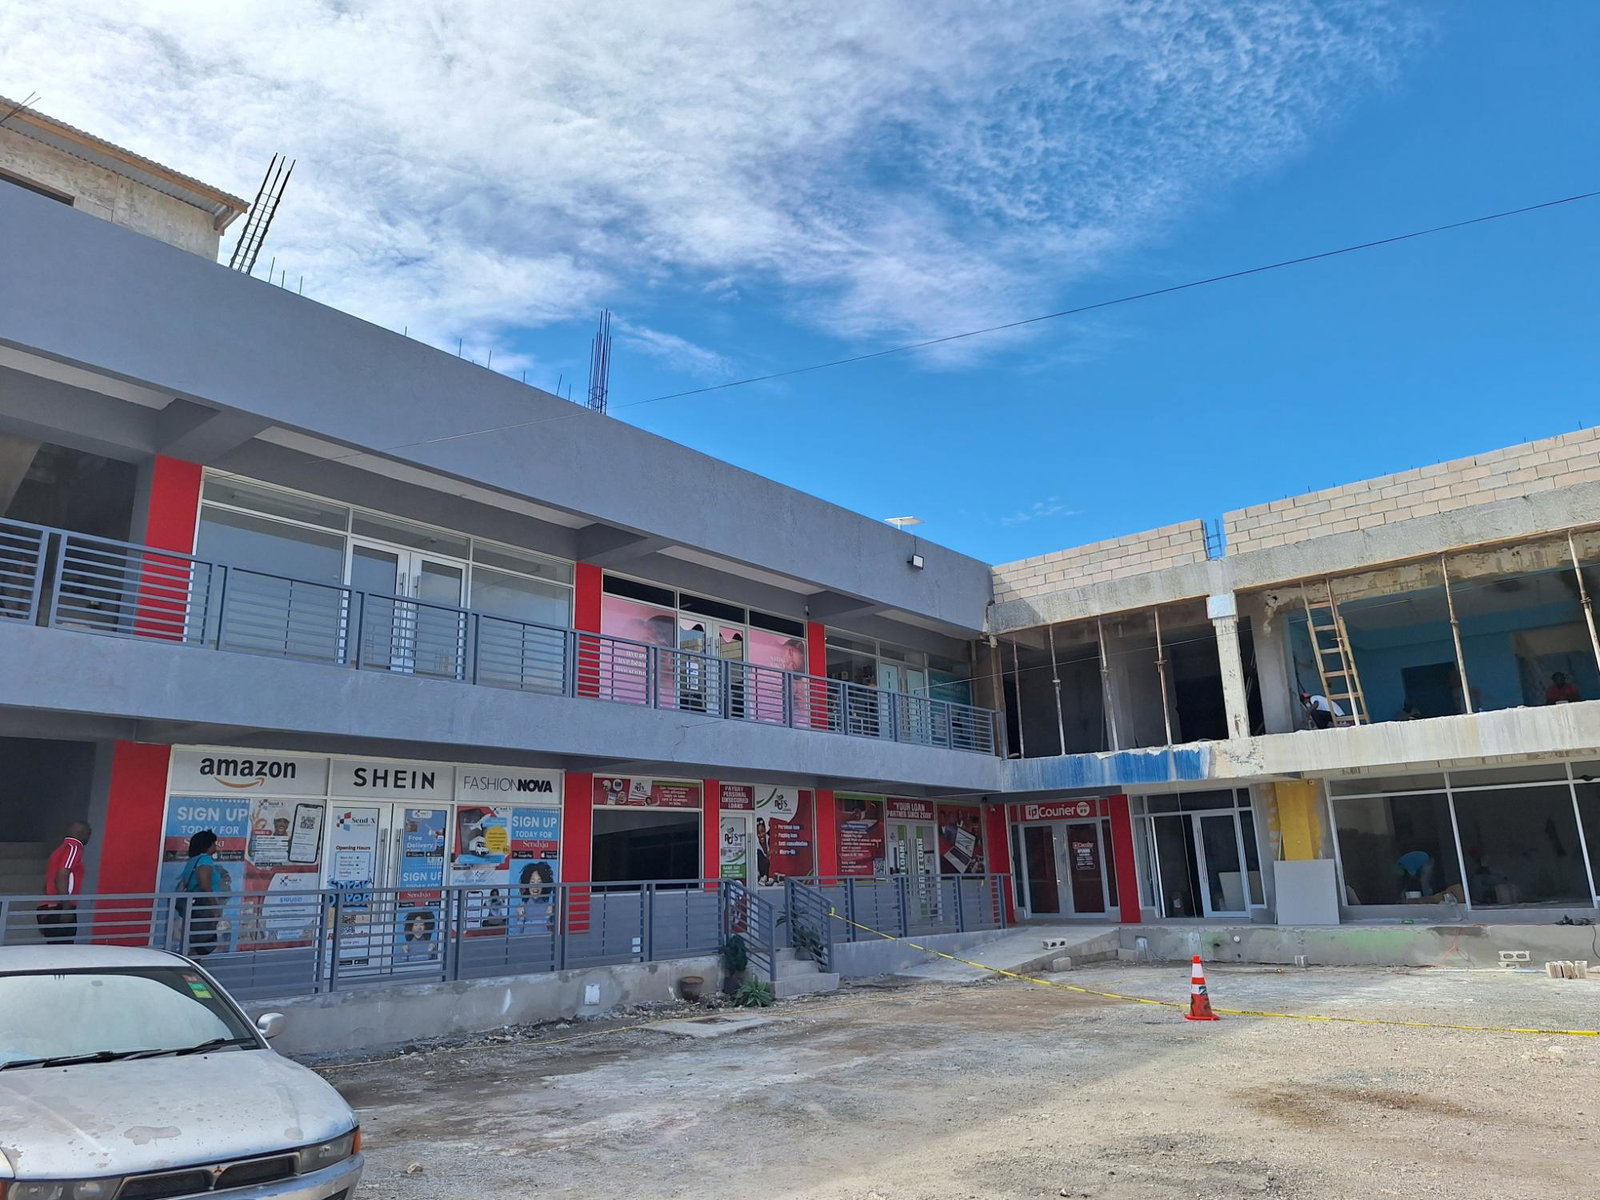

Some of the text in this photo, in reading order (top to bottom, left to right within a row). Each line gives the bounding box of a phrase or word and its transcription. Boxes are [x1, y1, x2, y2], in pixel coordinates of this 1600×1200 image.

[199, 757, 296, 779] amazon
[353, 767, 436, 790] SHEIN
[911, 802, 925, 812] LOAN
[177, 806, 249, 822] SIGN UP
[351, 816, 368, 824] Send
[512, 815, 540, 828] SIGN
[543, 817, 557, 828] UP
[219, 825, 240, 835] FOR
[515, 830, 538, 838] TODAY
[403, 872, 427, 882] SIGN
